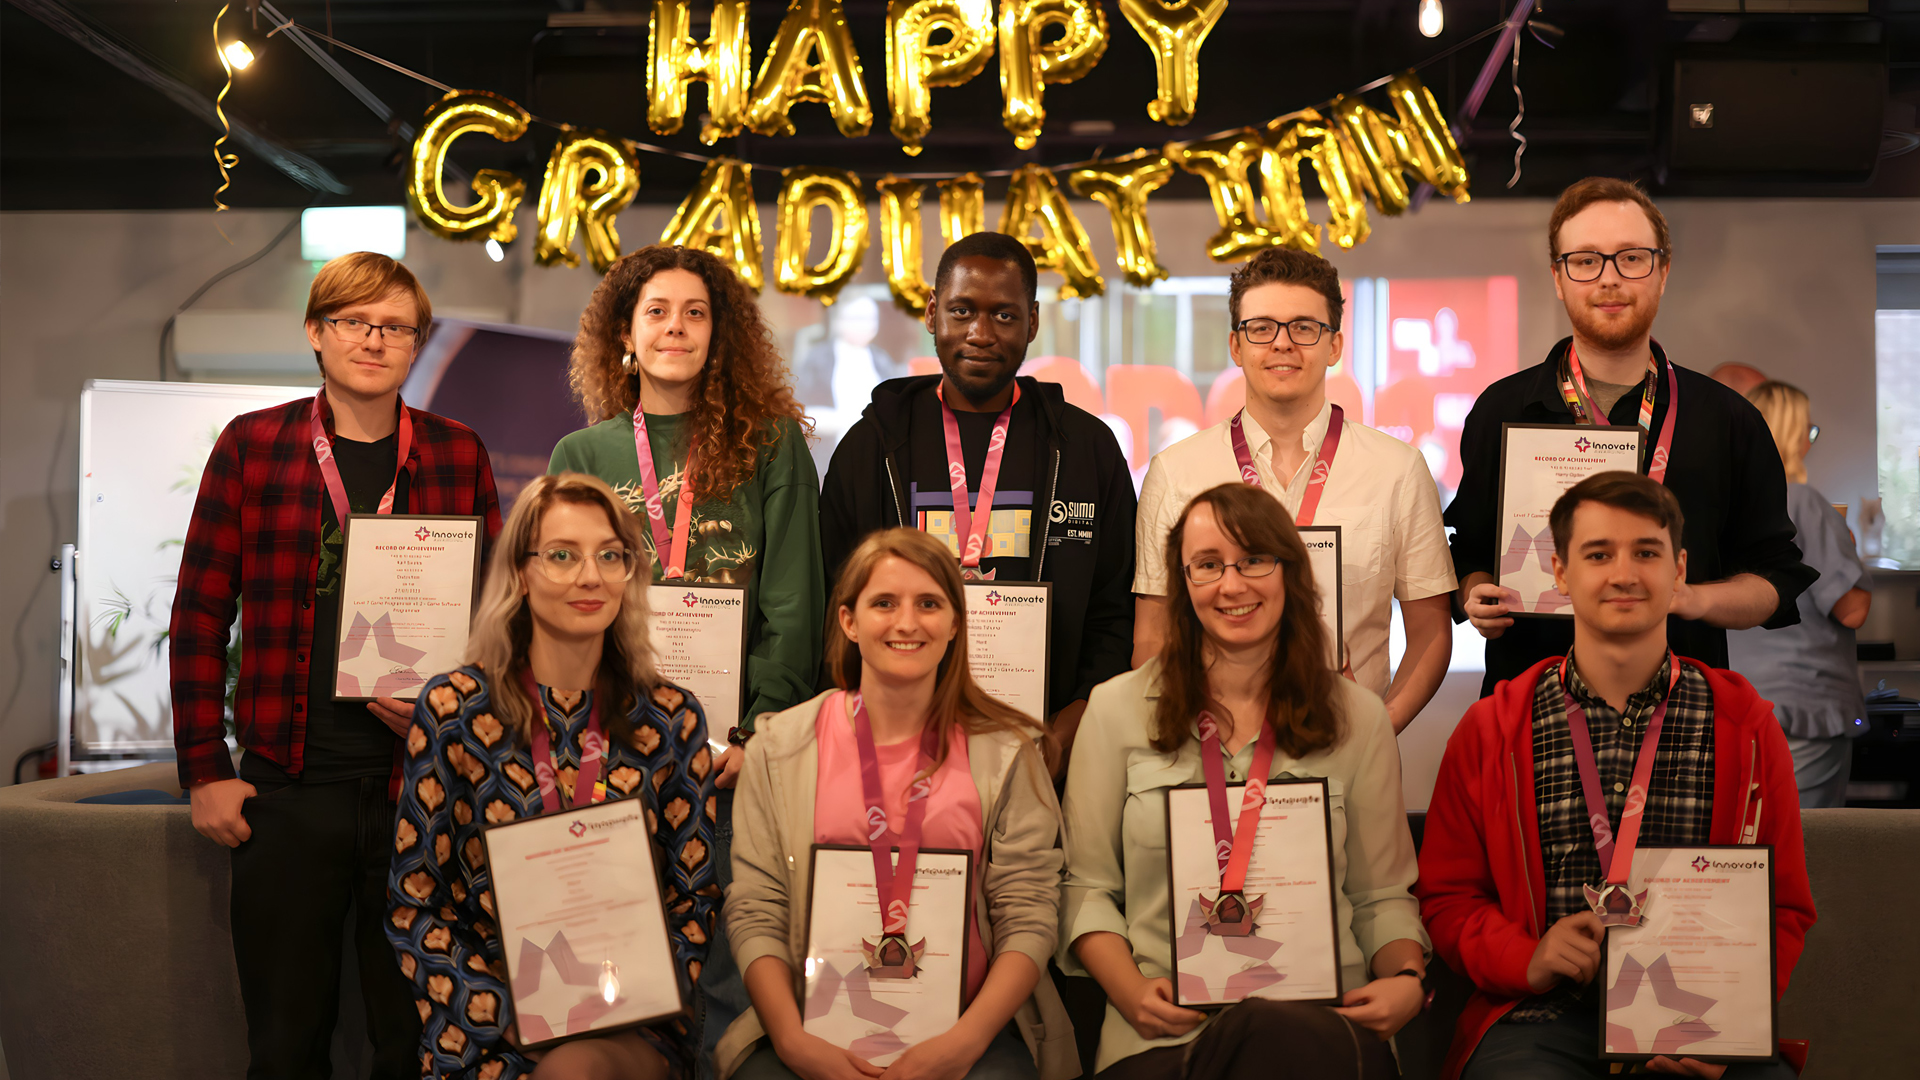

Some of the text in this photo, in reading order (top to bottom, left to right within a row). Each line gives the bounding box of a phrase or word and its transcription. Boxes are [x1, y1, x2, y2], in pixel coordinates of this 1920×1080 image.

[646, 0, 1229, 156] HAPPY
[1592, 441, 1636, 451] Innovate
[1068, 501, 1095, 518] SUMO
[431, 530, 474, 539] Innovate
[1306, 540, 1334, 549] ovate
[700, 597, 741, 605] Innovate
[1003, 595, 1044, 604] Innovate
[1712, 860, 1765, 870] Innovate
